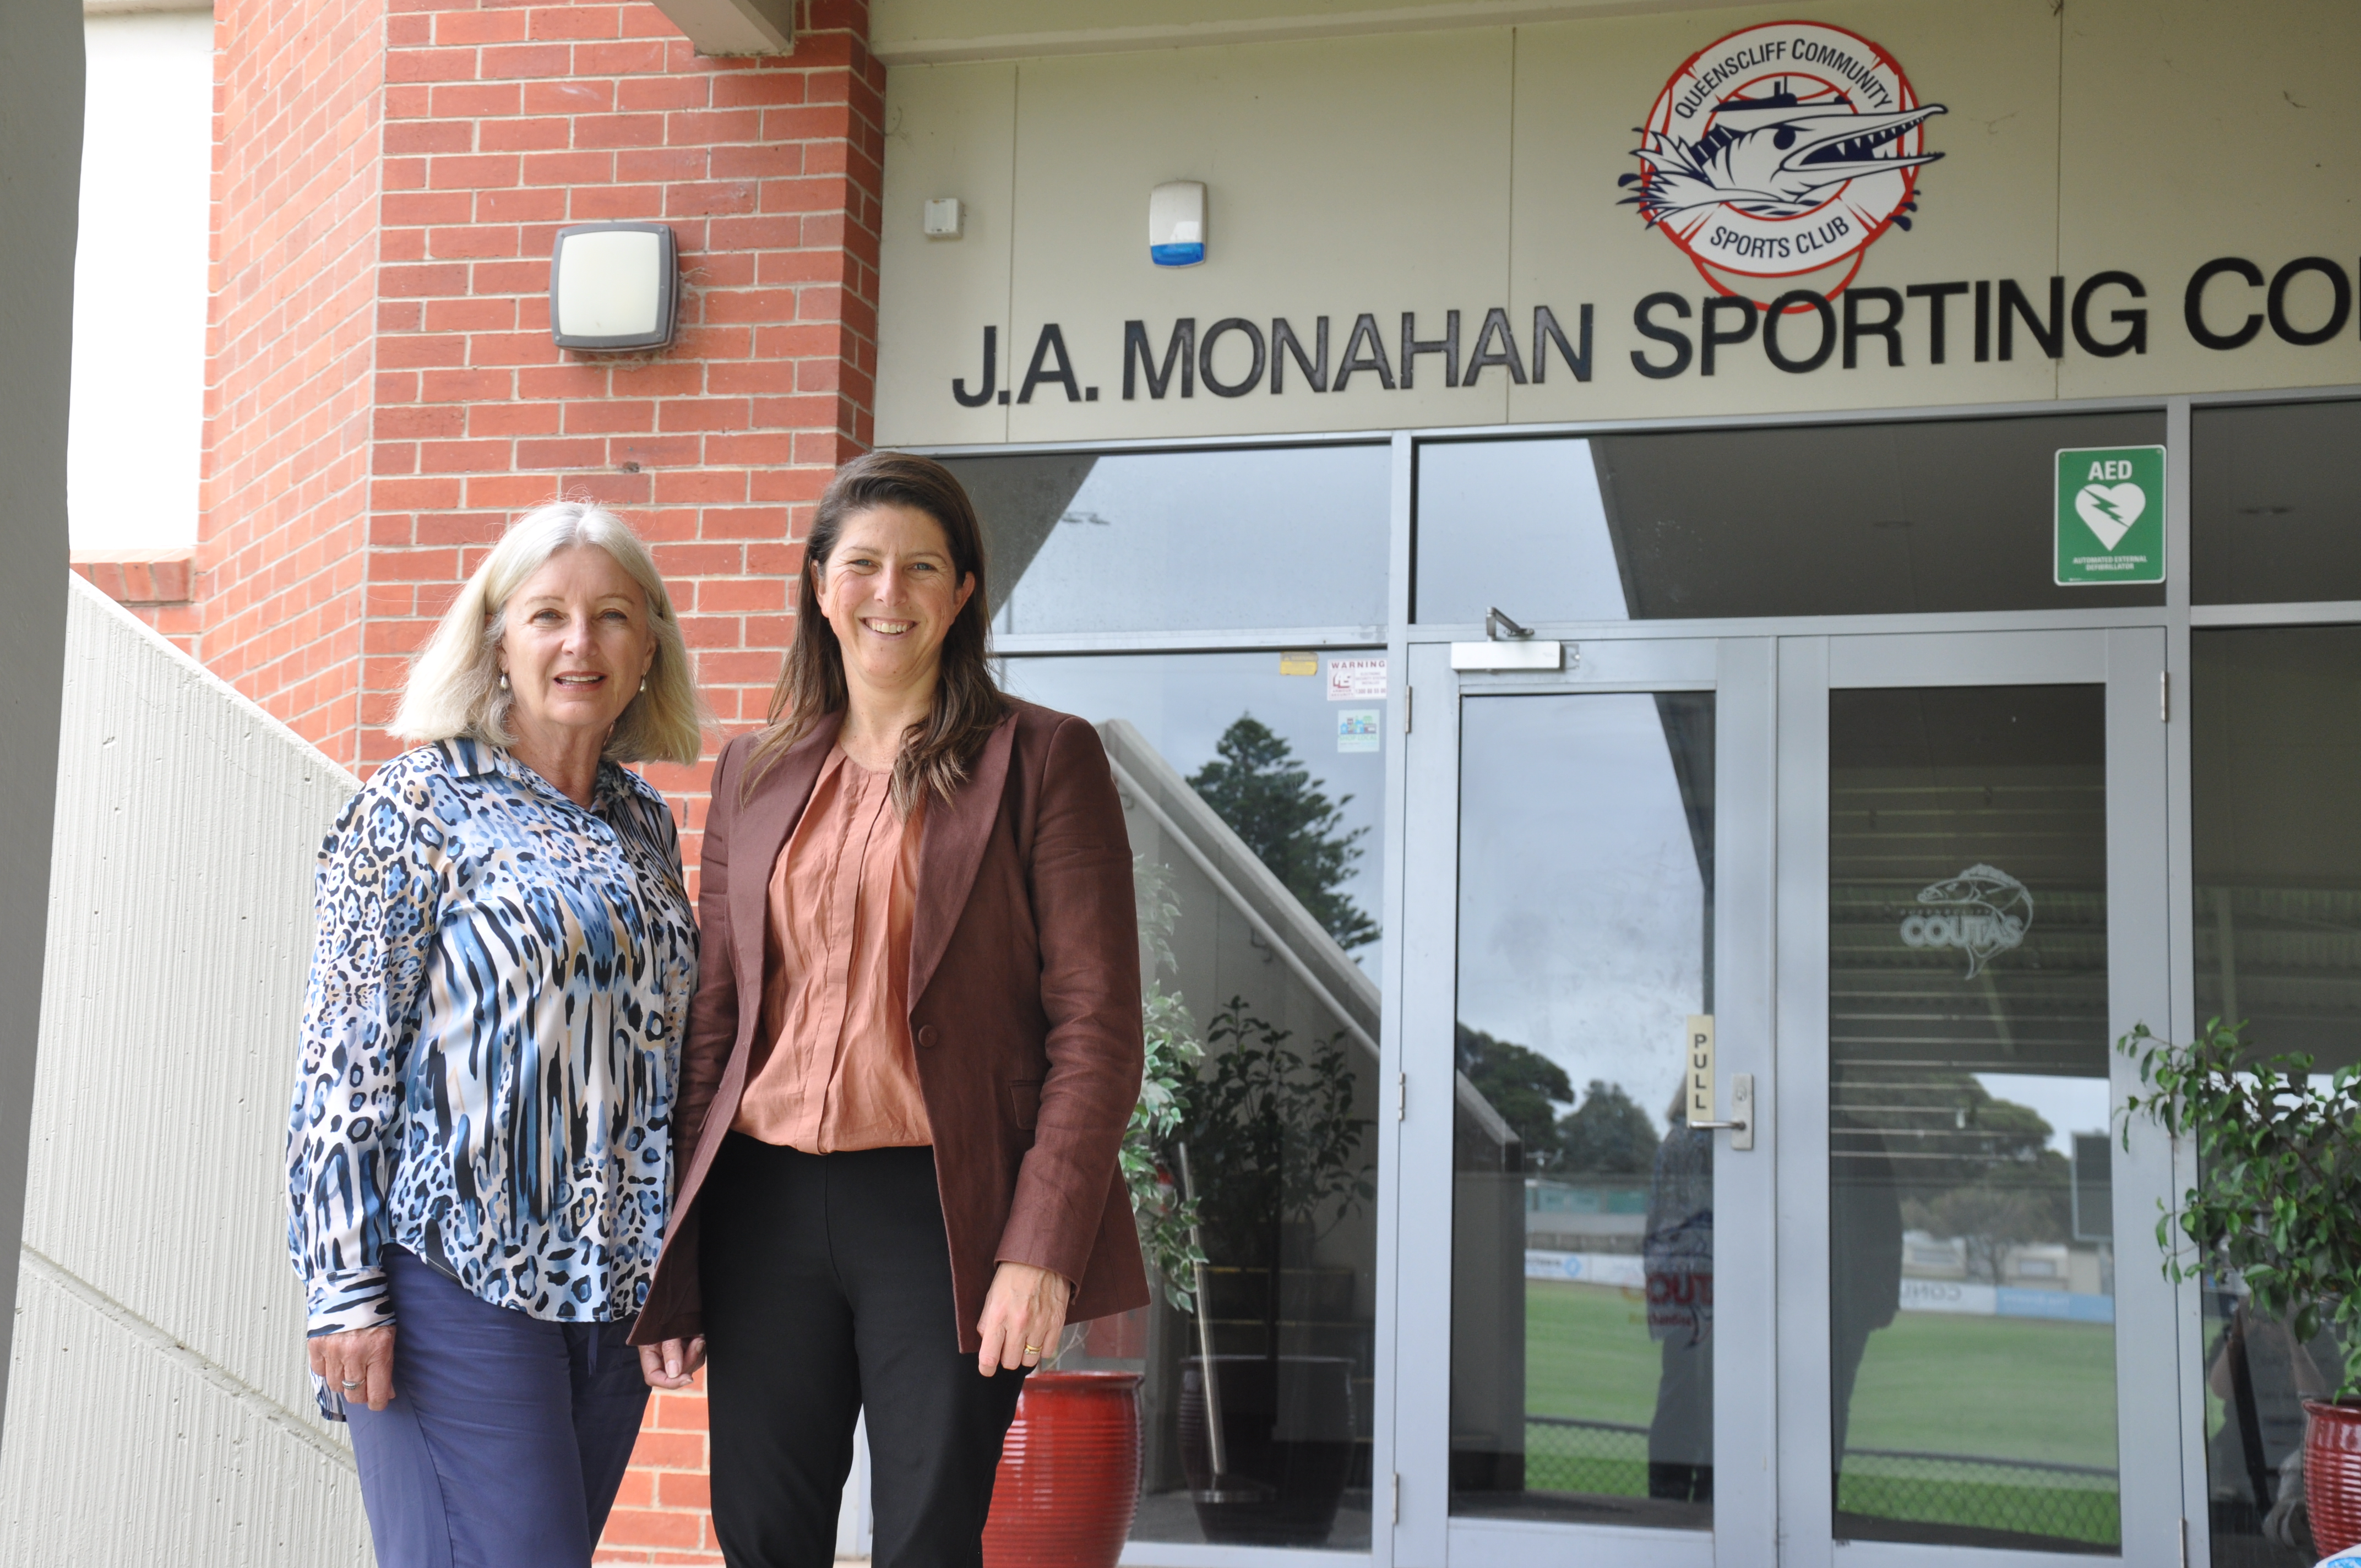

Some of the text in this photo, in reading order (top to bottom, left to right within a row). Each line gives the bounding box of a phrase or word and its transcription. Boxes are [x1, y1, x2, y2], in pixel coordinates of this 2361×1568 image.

[1674, 38, 1892, 119] QUEENSCLIFF COMMUNITY
[1710, 216, 1849, 258] SPORTS CLUB
[1122, 303, 1594, 400] MONAHAN
[1630, 270, 2147, 379] SPORTING
[2184, 256, 2361, 351] CO
[2088, 460, 2132, 481] AED
[2073, 556, 2113, 564] AUTOMATED
[1331, 660, 1385, 669] WARNING
[1694, 1034, 1707, 1109] PULL
